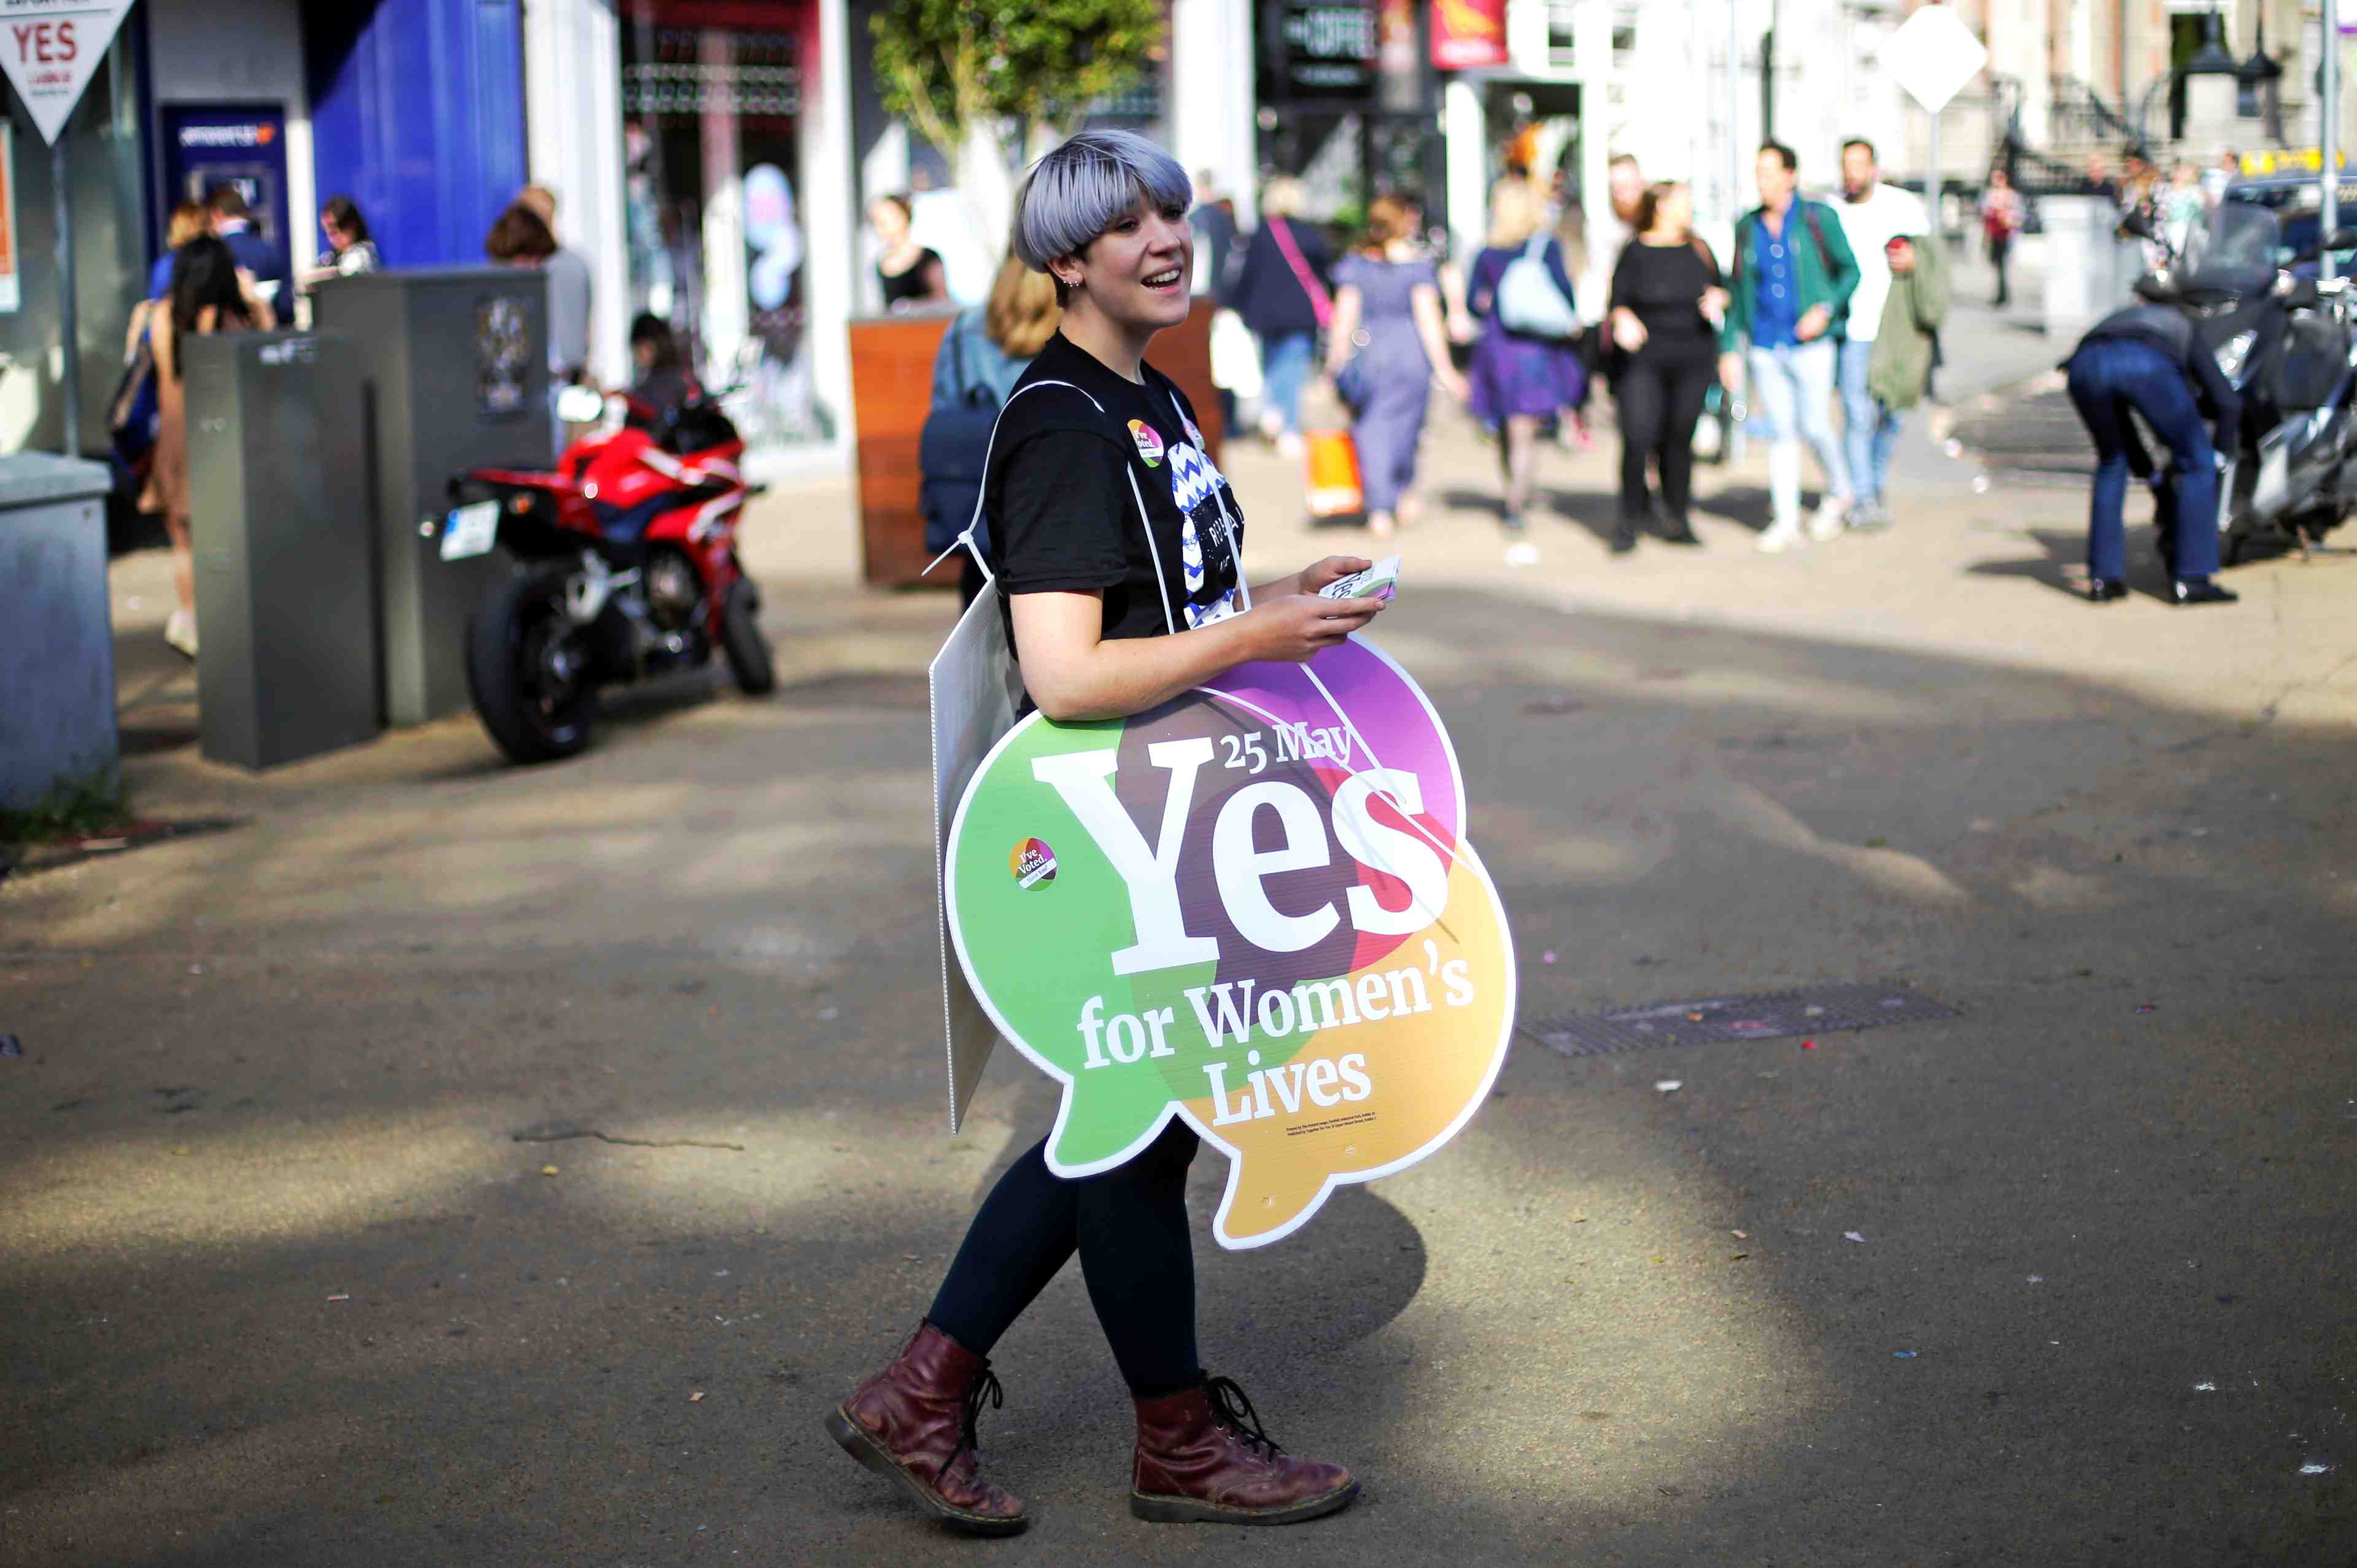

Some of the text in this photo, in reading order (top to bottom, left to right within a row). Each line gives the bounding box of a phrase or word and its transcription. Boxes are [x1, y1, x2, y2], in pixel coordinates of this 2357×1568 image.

[12, 21, 78, 63] YES
[1219, 721, 1352, 774] 25 May
[1018, 854, 1048, 875] Voted.
[1019, 849, 1039, 864] I've
[1032, 736, 1448, 976] Yes
[1077, 939, 1474, 1070] for Women's
[1203, 1049, 1372, 1127] Lives
